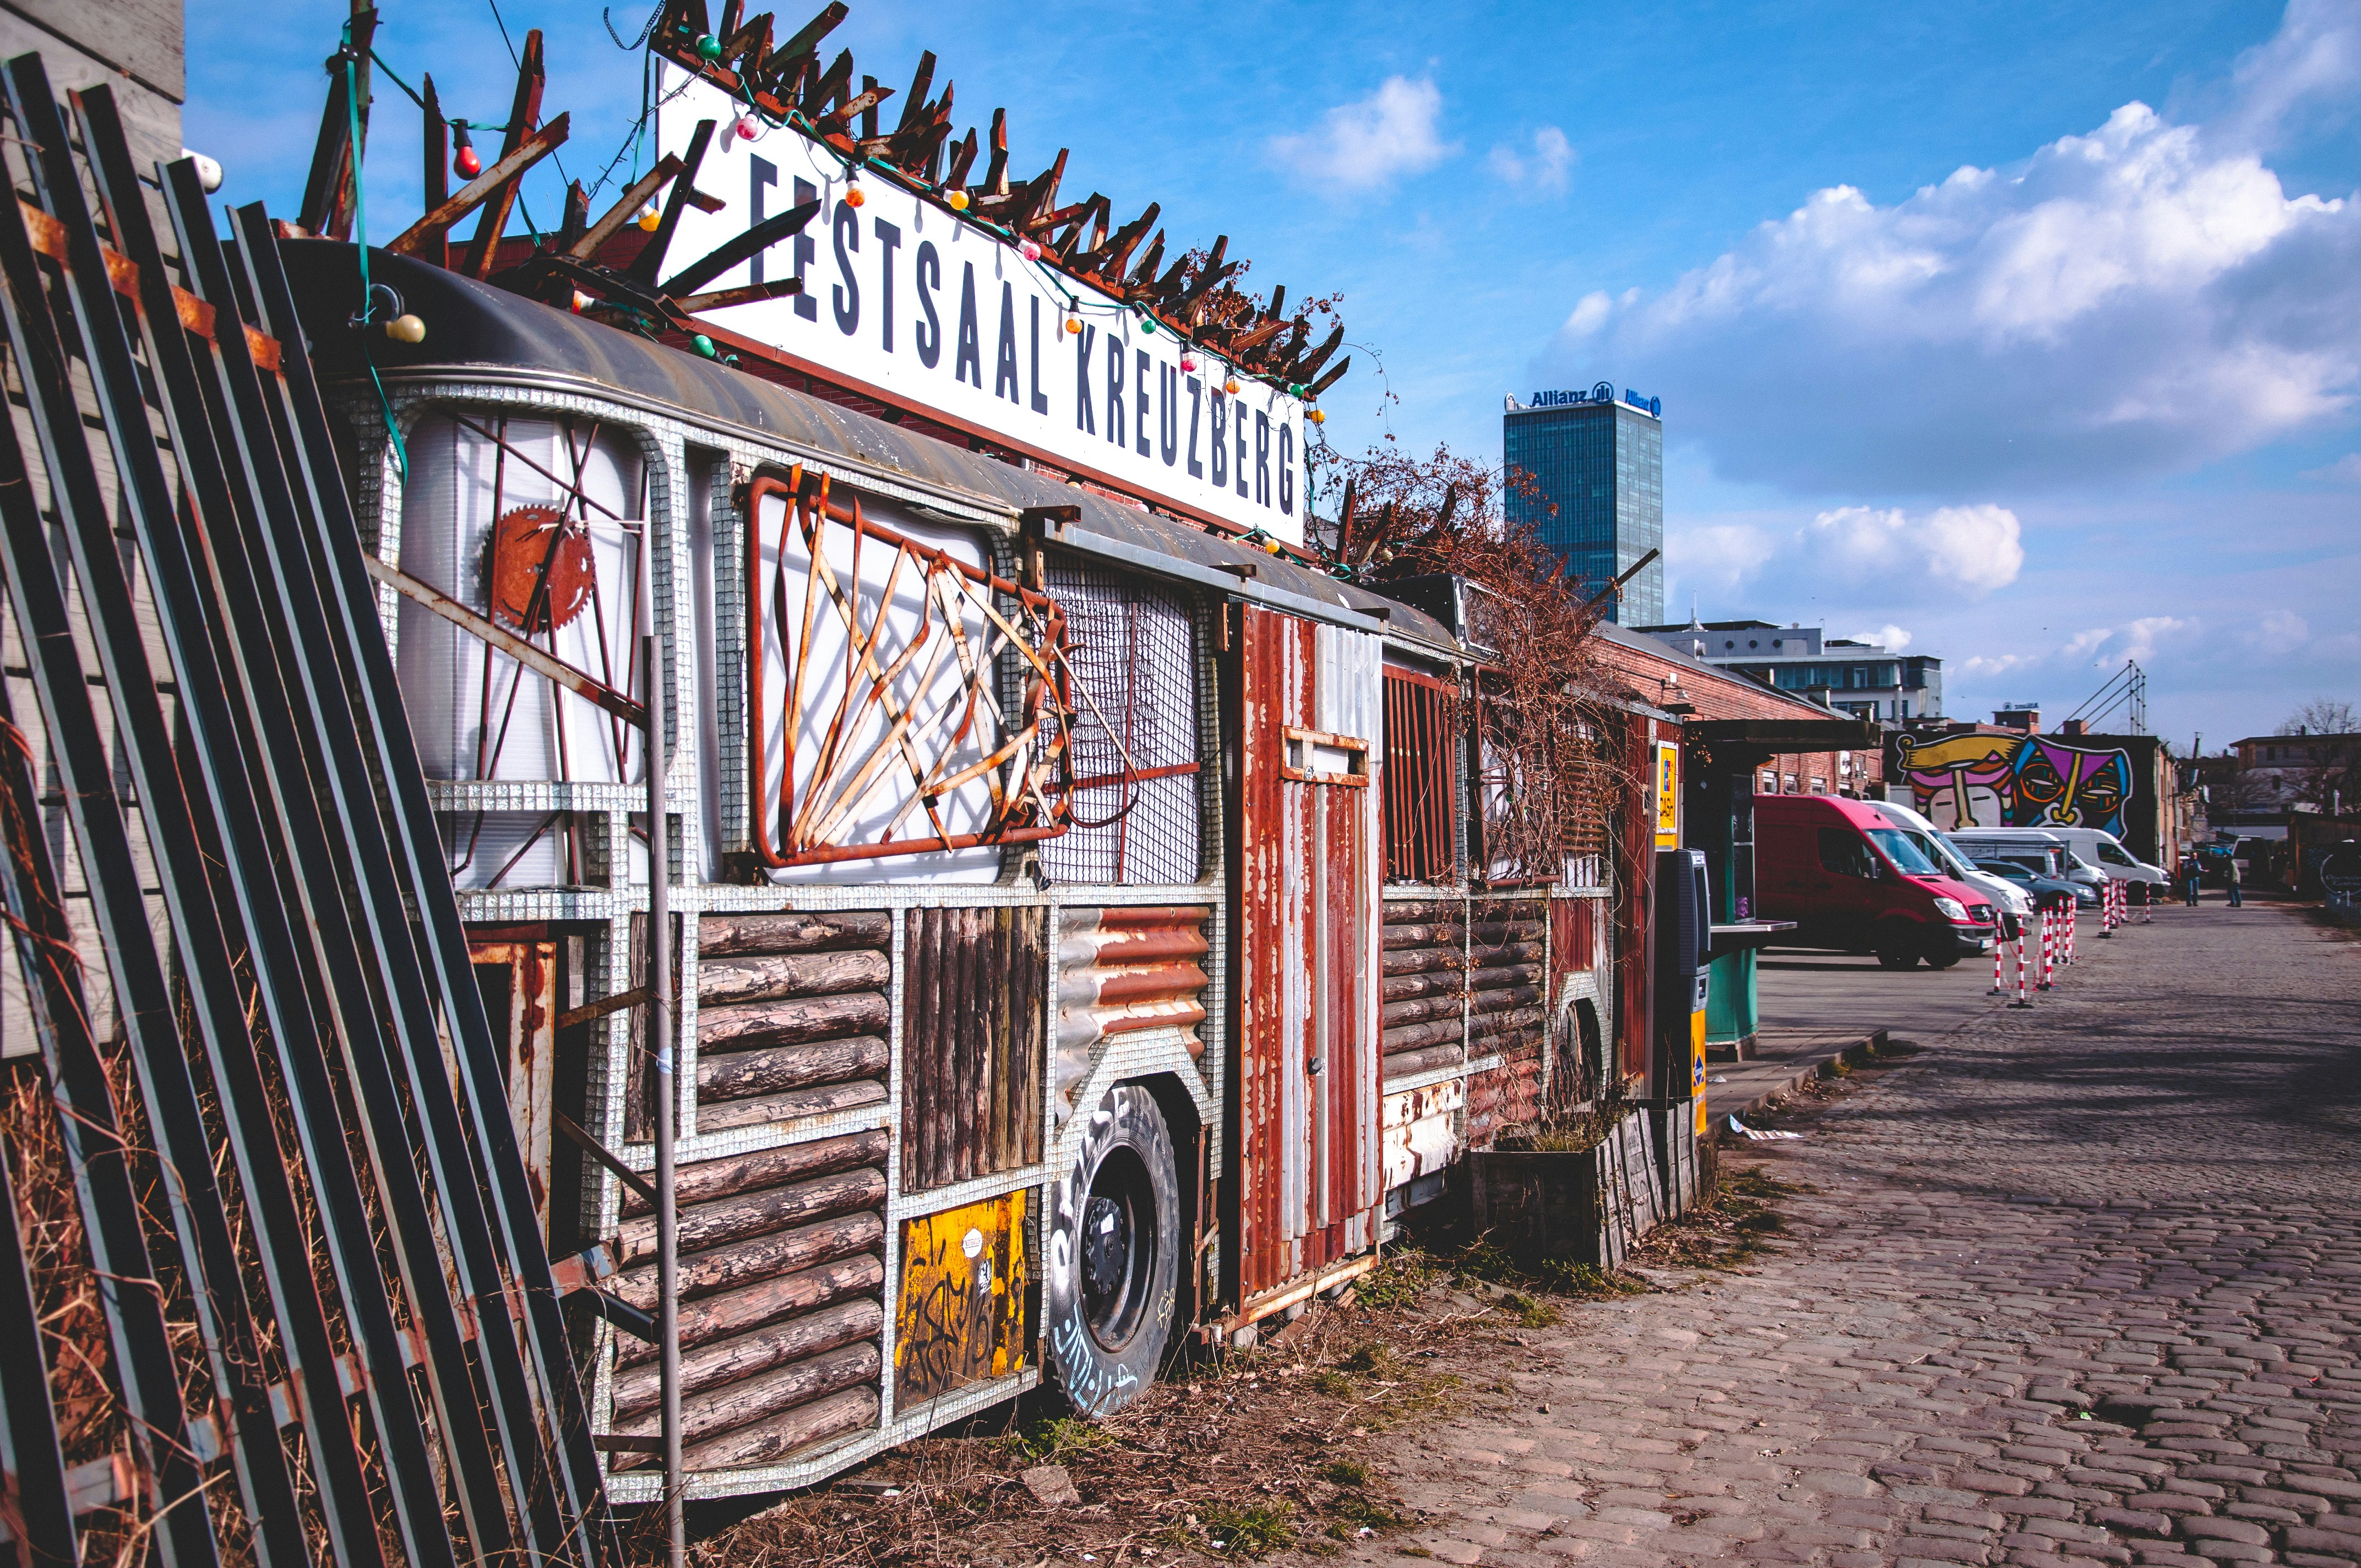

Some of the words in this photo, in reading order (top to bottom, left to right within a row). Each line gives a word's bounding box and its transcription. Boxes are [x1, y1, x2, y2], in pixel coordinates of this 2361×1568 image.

[750, 153, 1048, 416] FESTSAAL
[1078, 319, 1293, 518] KREUZBERG
[1531, 390, 1587, 407] Allianz
